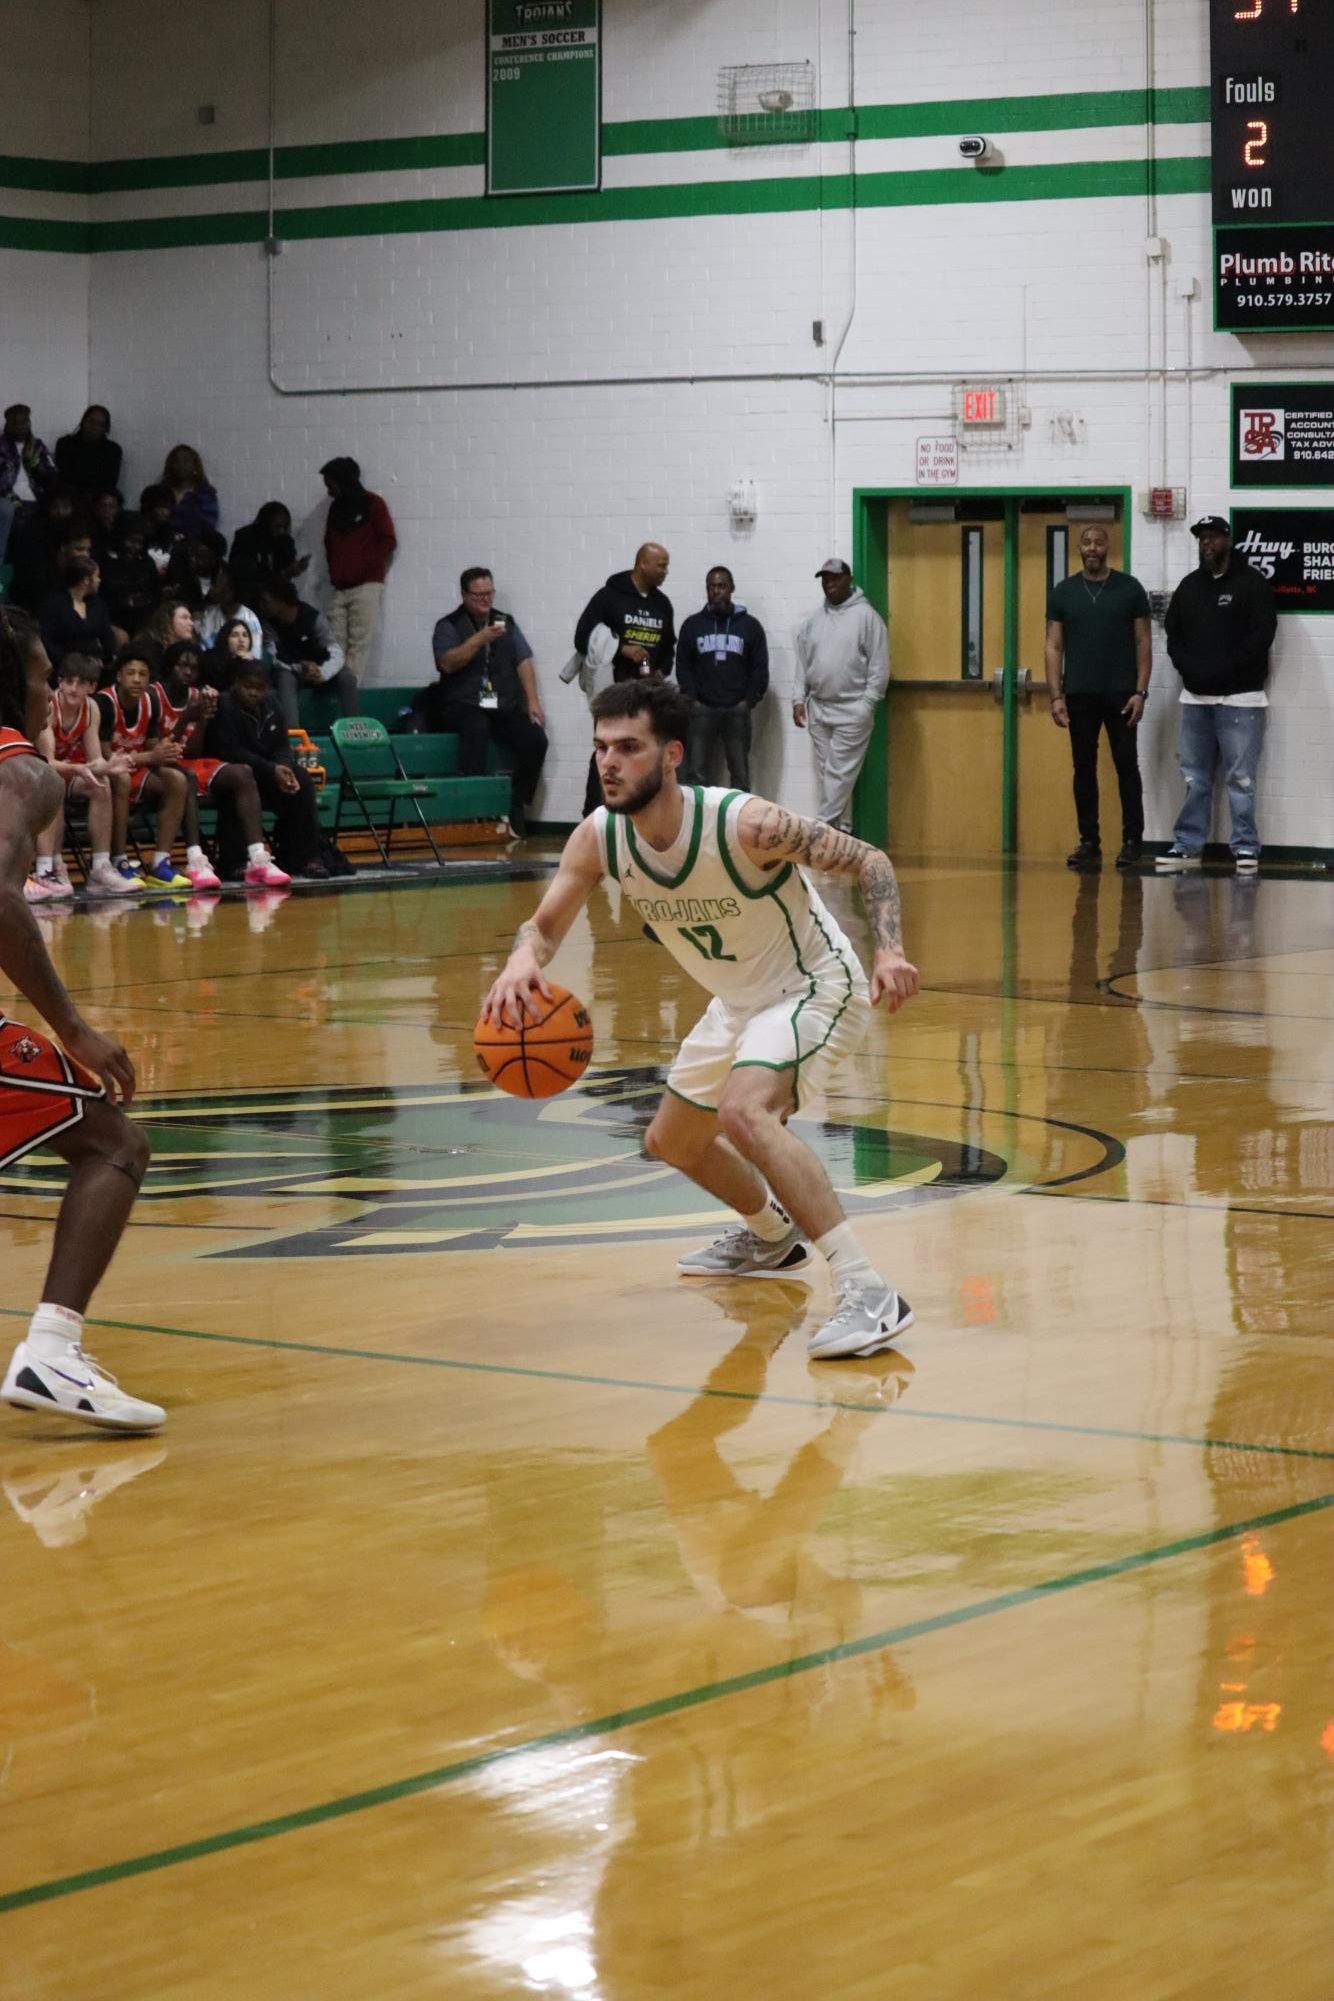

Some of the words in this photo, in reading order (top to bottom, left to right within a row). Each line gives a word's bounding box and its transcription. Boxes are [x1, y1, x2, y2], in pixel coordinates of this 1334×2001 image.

[502, 35, 537, 48] MEN'S
[542, 31, 586, 45] SOCCER
[494, 53, 545, 66] CONFERENCE
[547, 50, 594, 61] CHAMPIONS
[493, 67, 521, 81] 2009
[1244, 121, 1268, 166] 2
[1220, 251, 1294, 275] Plumb
[1300, 251, 1334, 272] Rit
[1220, 275, 1334, 287] PLUMBIN
[1237, 293, 1332, 307] 910.579.3757
[964, 390, 996, 421] EXIT
[920, 443, 931, 453] NO
[935, 443, 954, 453] FOOD
[920, 456, 929, 466] OR
[933, 456, 955, 465] DRINK
[927, 469, 939, 478] THE
[941, 469, 956, 479] GYM
[1235, 530, 1295, 560] Hwy
[1248, 556, 1276, 579] 55
[1303, 555, 1334, 567] SHA
[1303, 569, 1334, 580] FRIE
[624, 614, 663, 629] DANIELS
[628, 896, 741, 922] ROJANS
[677, 925, 737, 962] 12
